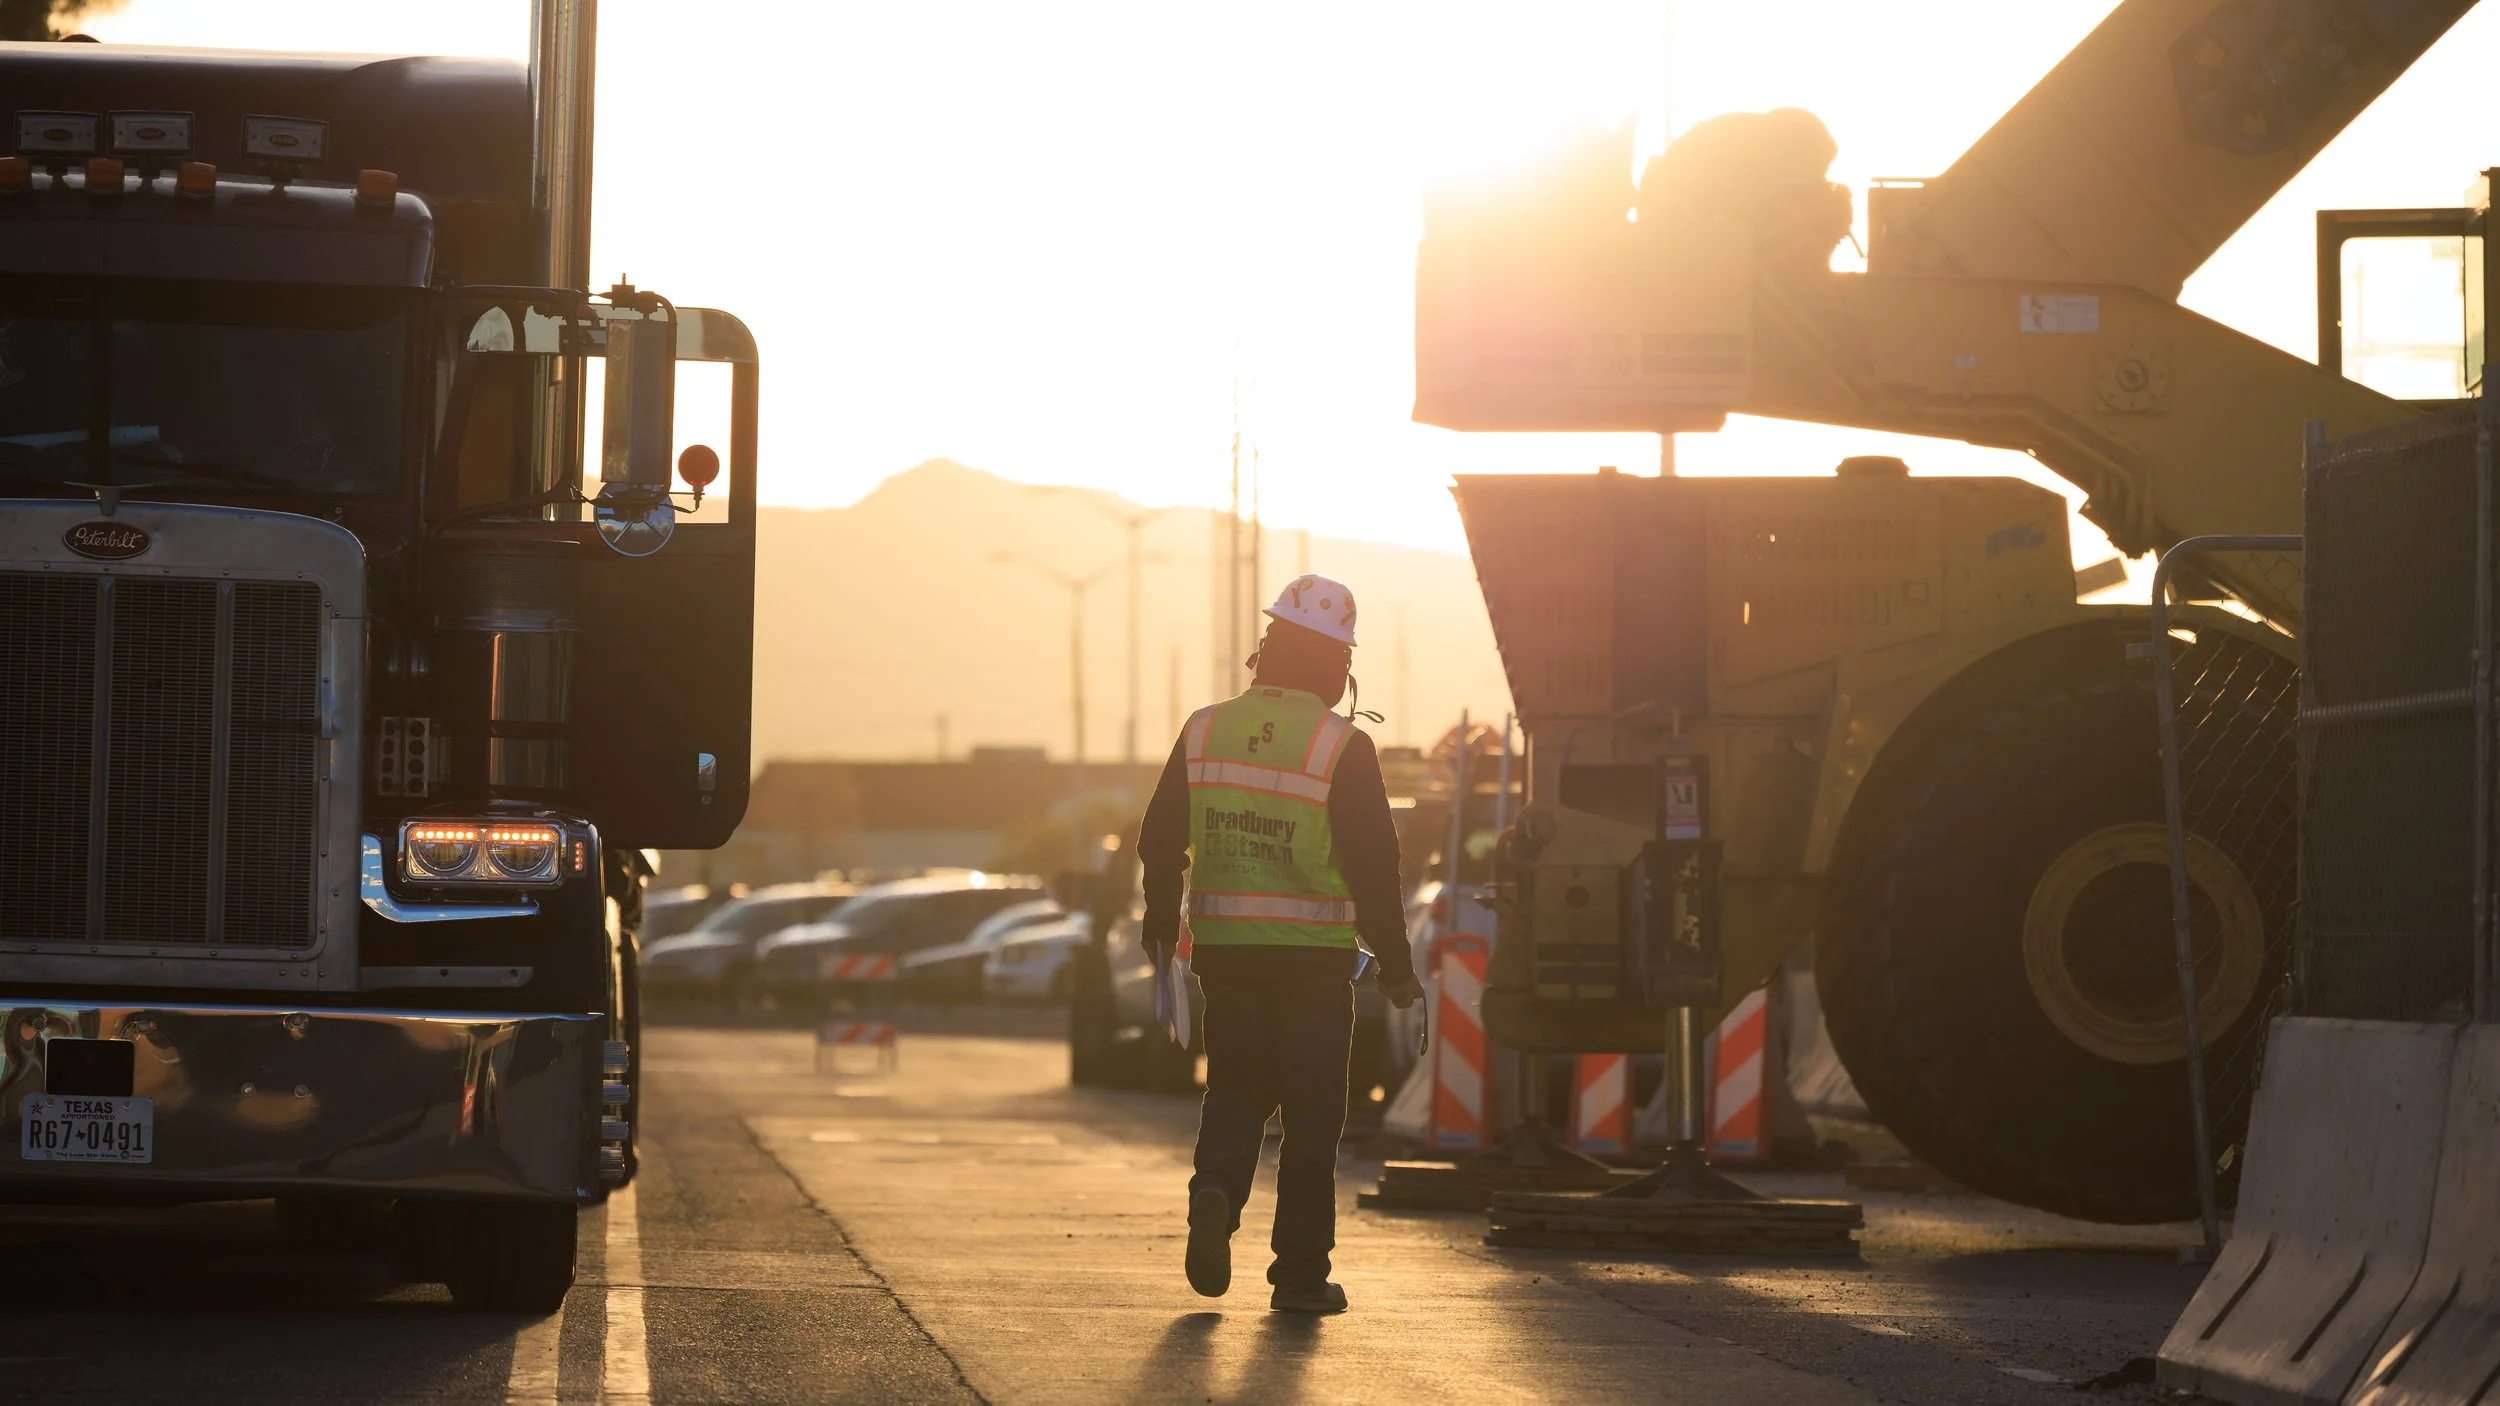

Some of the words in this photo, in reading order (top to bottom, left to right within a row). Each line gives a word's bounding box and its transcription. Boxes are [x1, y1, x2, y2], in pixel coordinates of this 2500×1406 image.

[74, 527, 142, 549] Peterbilt
[1205, 807, 1297, 844] Bradbury
[63, 1101, 113, 1114] TEXAS
[60, 1113, 116, 1121] APPORTIONED
